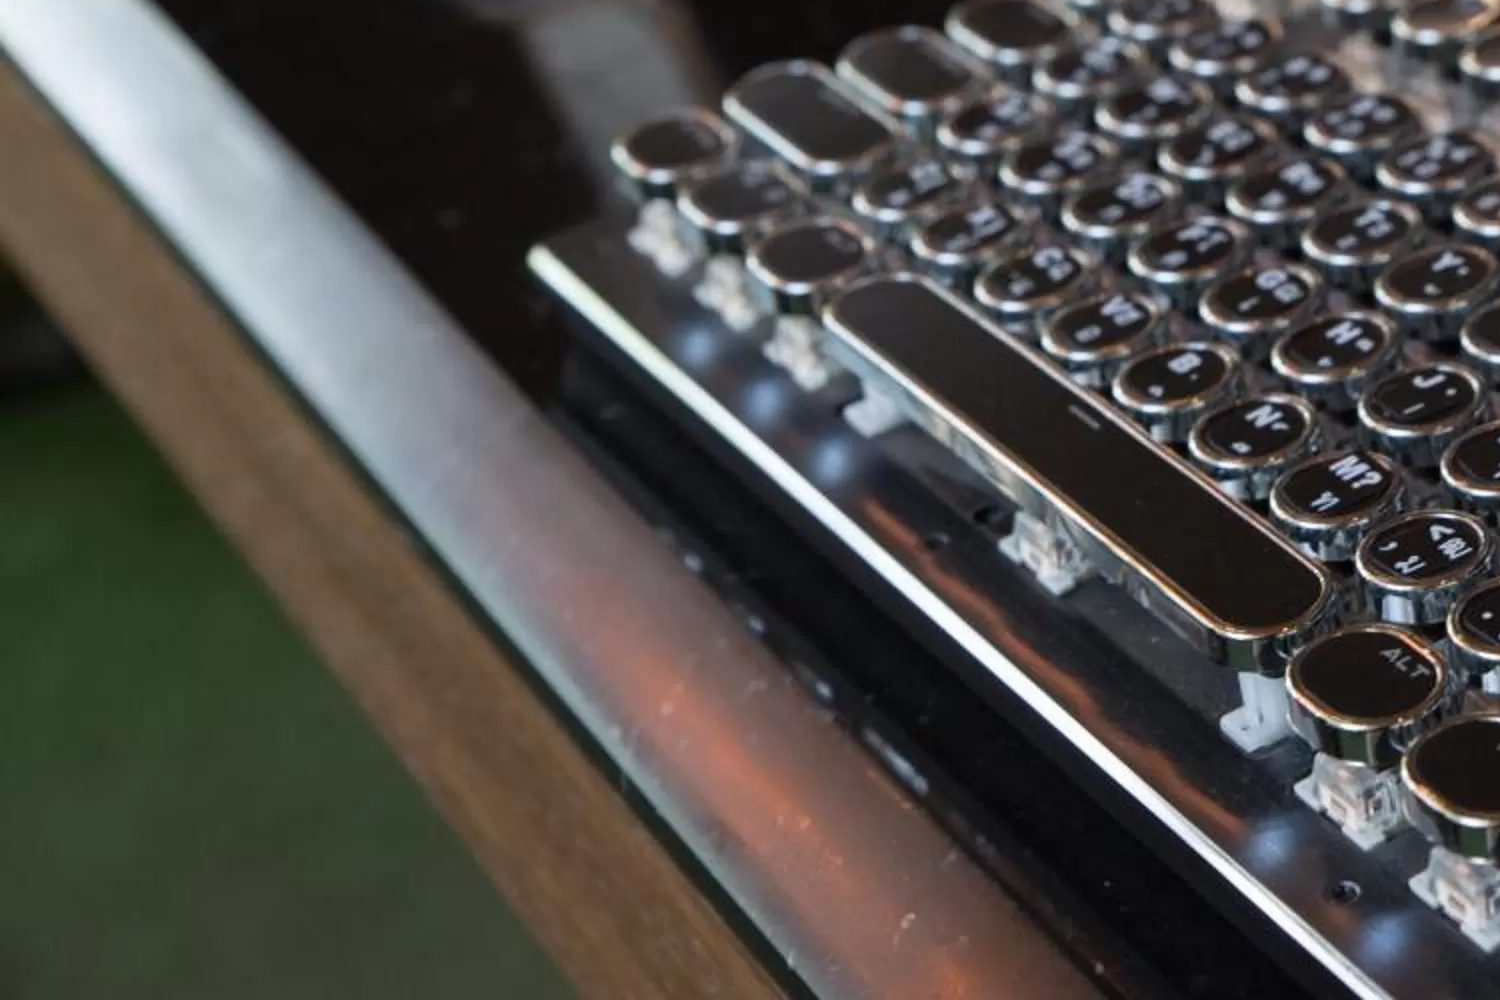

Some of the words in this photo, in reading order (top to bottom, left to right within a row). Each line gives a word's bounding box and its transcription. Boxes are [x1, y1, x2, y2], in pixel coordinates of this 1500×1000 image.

[1413, 374, 1446, 388] J
[1329, 454, 1367, 482] M
[1380, 647, 1431, 679] ALT
